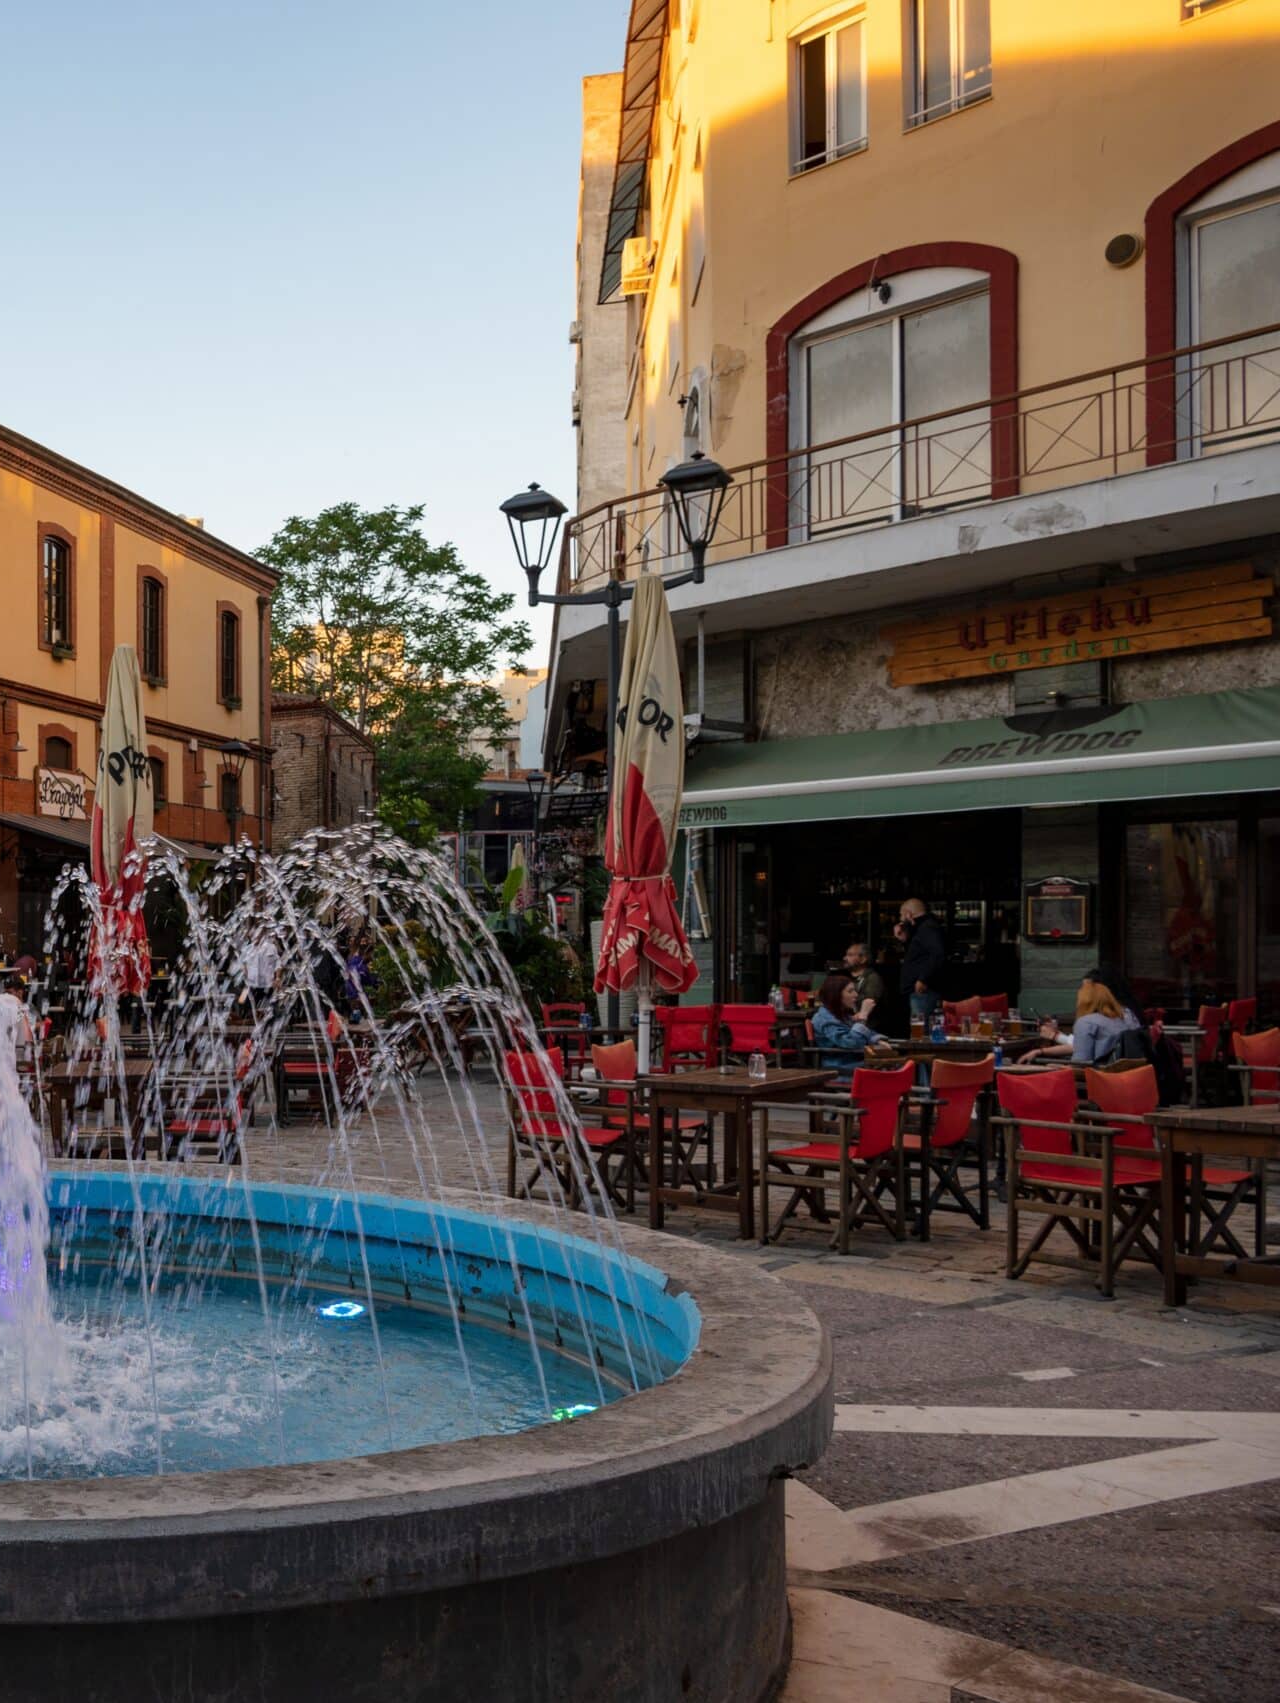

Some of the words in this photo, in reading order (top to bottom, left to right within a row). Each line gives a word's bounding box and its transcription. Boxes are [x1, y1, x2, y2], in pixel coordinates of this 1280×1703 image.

[988, 636, 1131, 669] Garden
[936, 728, 1144, 766] BREWDOG
[679, 805, 727, 824] REWDOG
